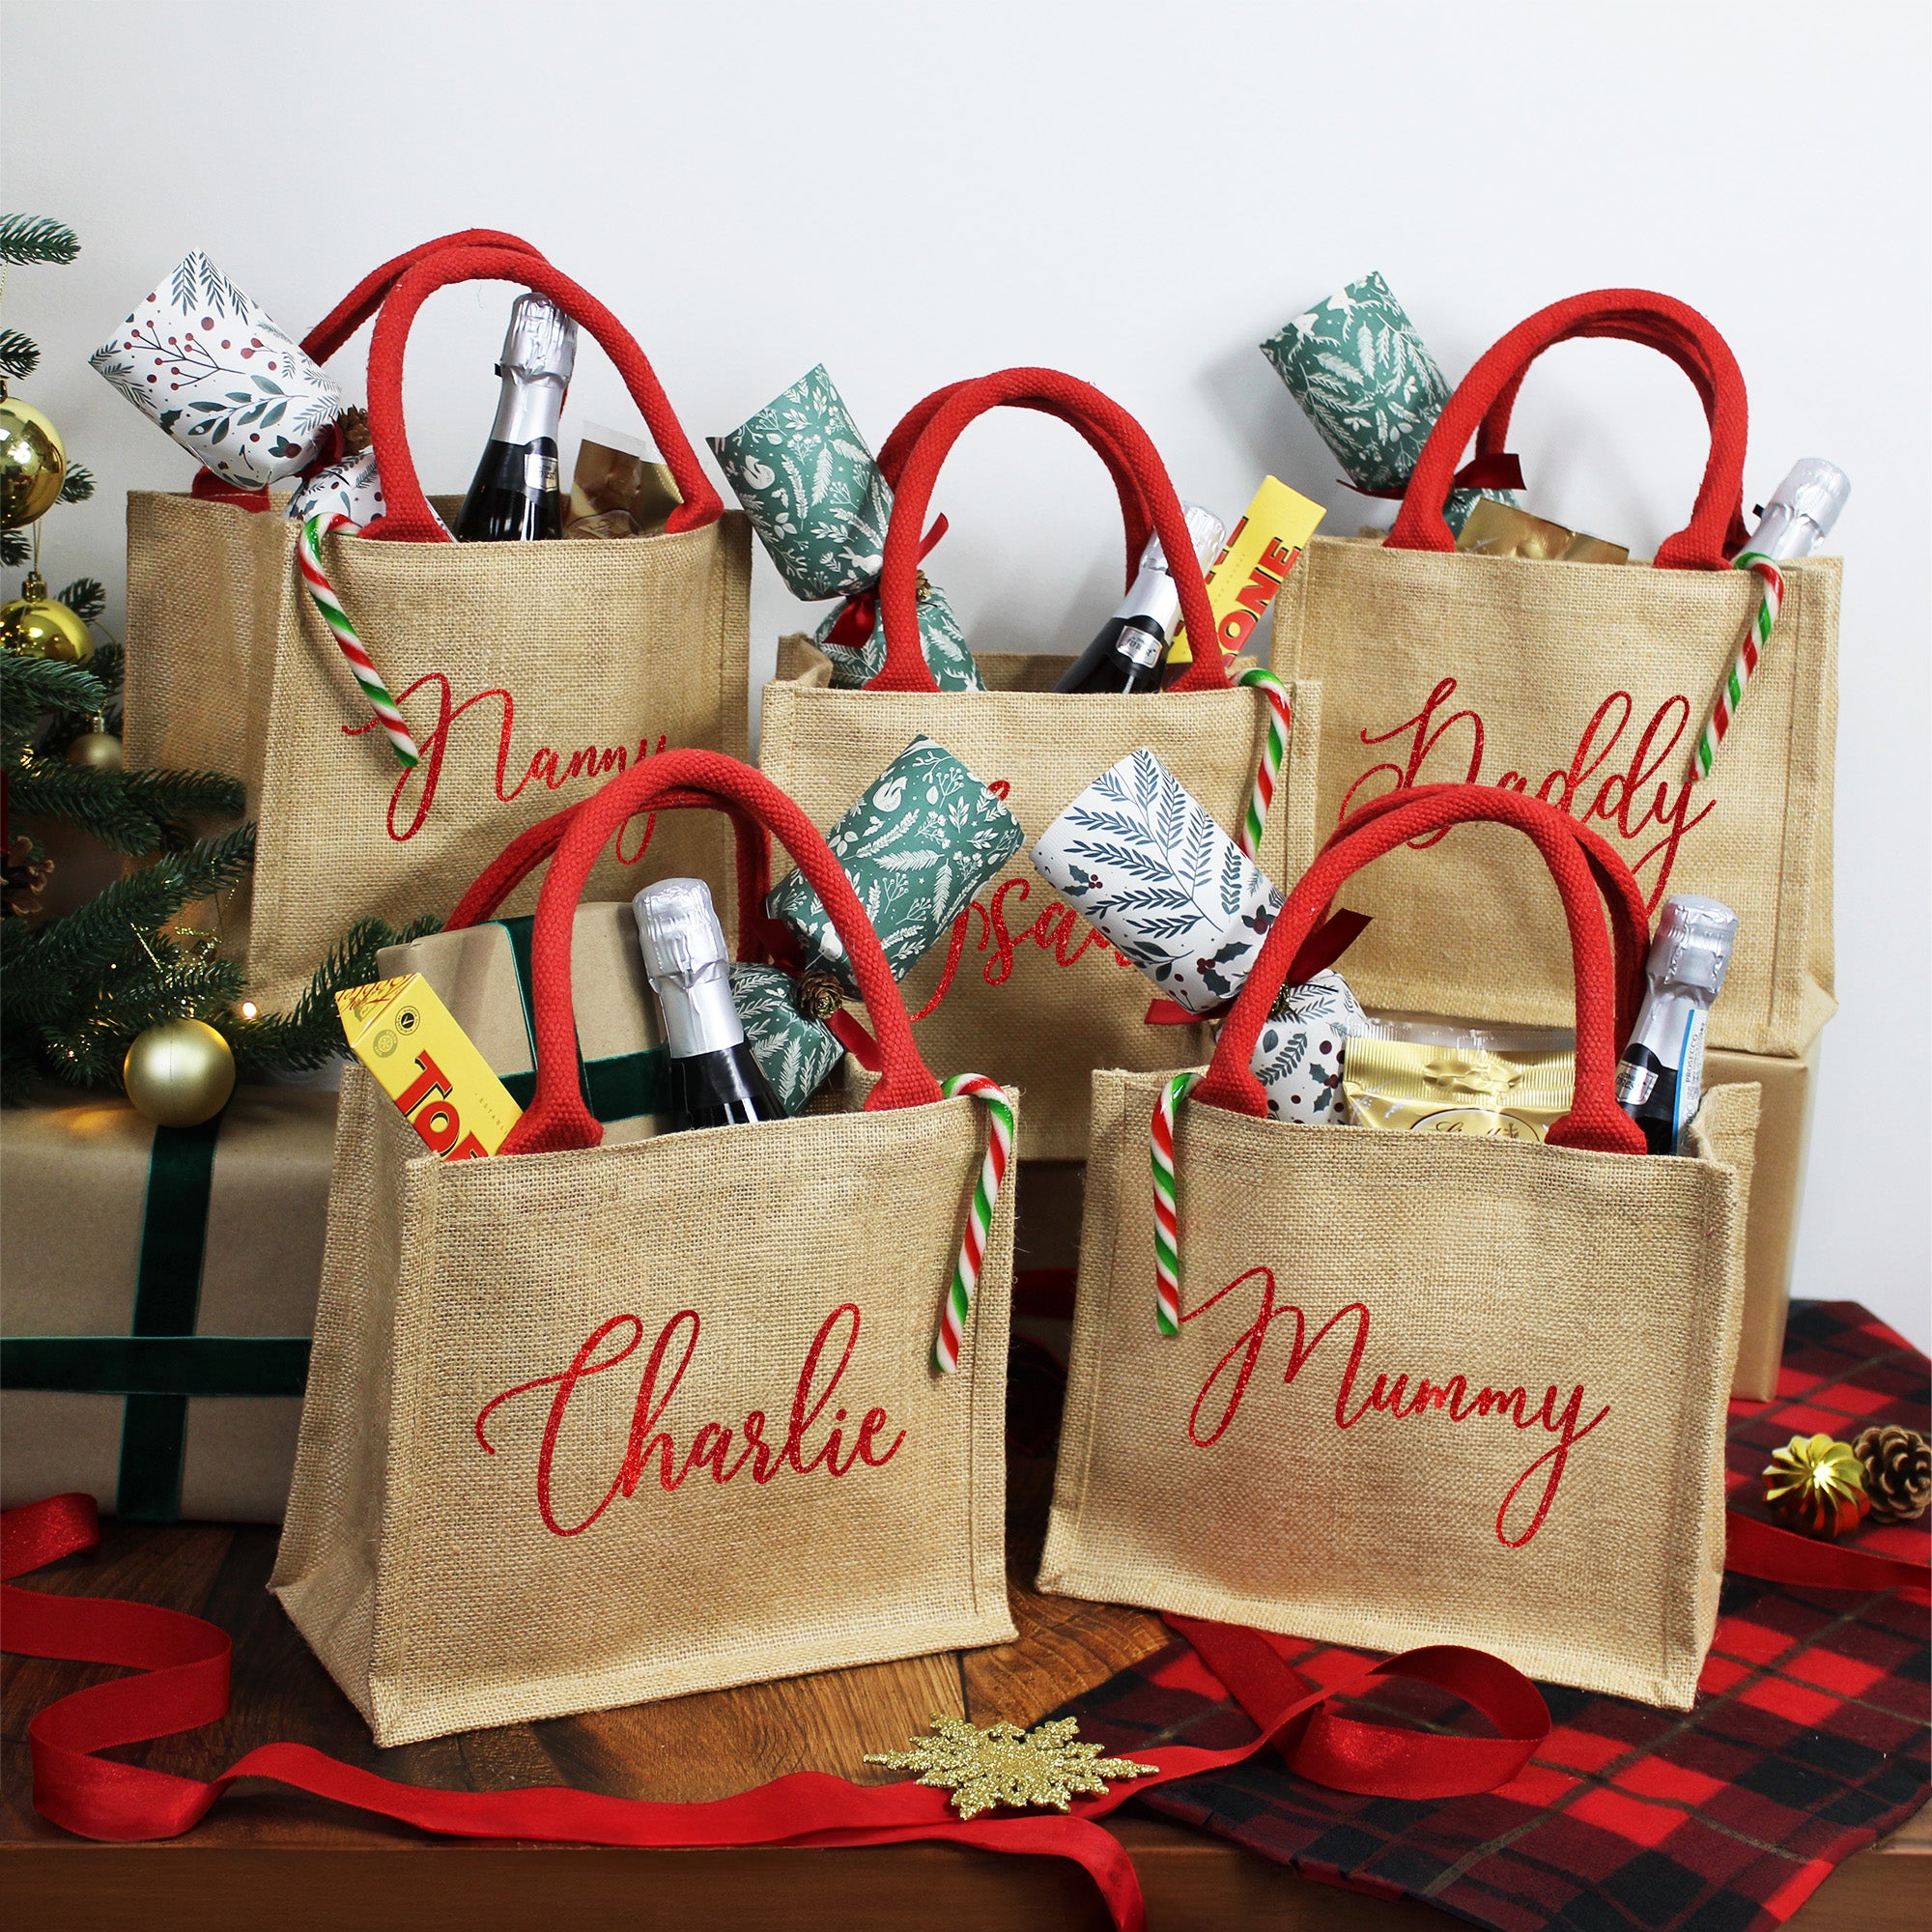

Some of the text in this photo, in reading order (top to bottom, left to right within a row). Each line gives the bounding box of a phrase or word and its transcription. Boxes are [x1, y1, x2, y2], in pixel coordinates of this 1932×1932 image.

[1218, 536, 1302, 668] ONE
[475, 1303, 906, 1537] Charlie
[1179, 1266, 1610, 1548] Mummy
